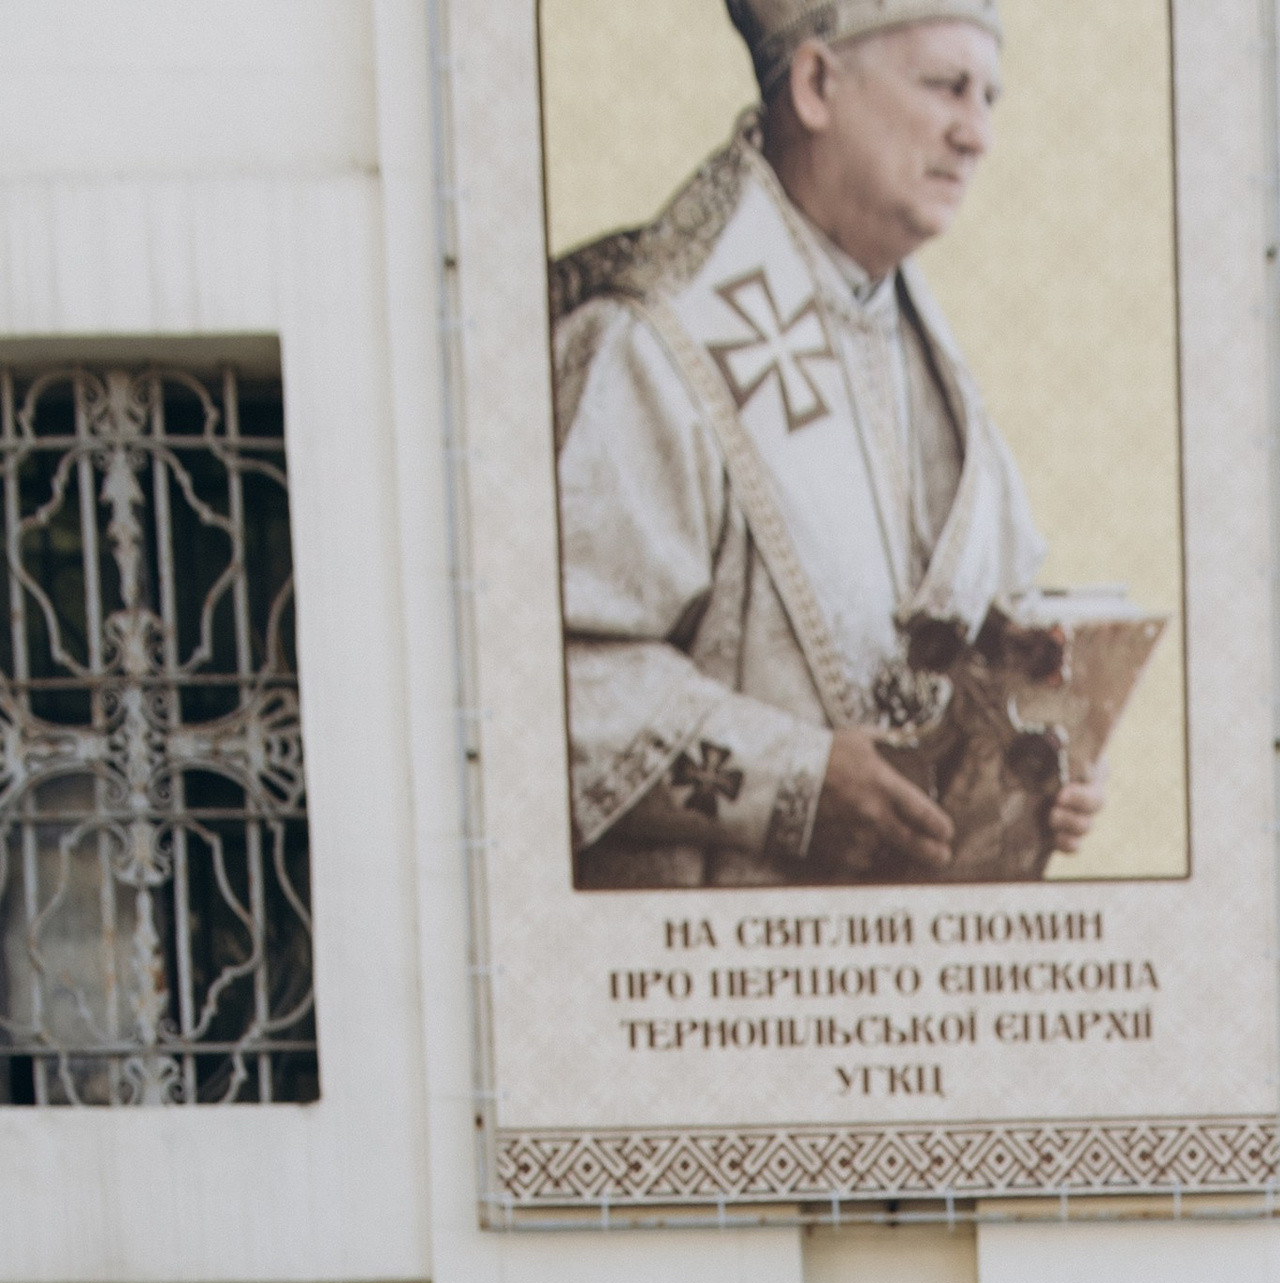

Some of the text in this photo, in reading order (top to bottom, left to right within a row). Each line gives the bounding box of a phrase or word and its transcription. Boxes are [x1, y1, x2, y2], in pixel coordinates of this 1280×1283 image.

[664, 909, 1103, 951] НА СВІТЛИЙ СПОМИН
[609, 960, 1160, 1001] ПРО ПЕРШОГО ЄПИСКОПА
[620, 1003, 1153, 1051] ТЕРНОПІЛЬСЬКОЇ ЄПАРХІЇ
[835, 1064, 946, 1099] УГКЦ
